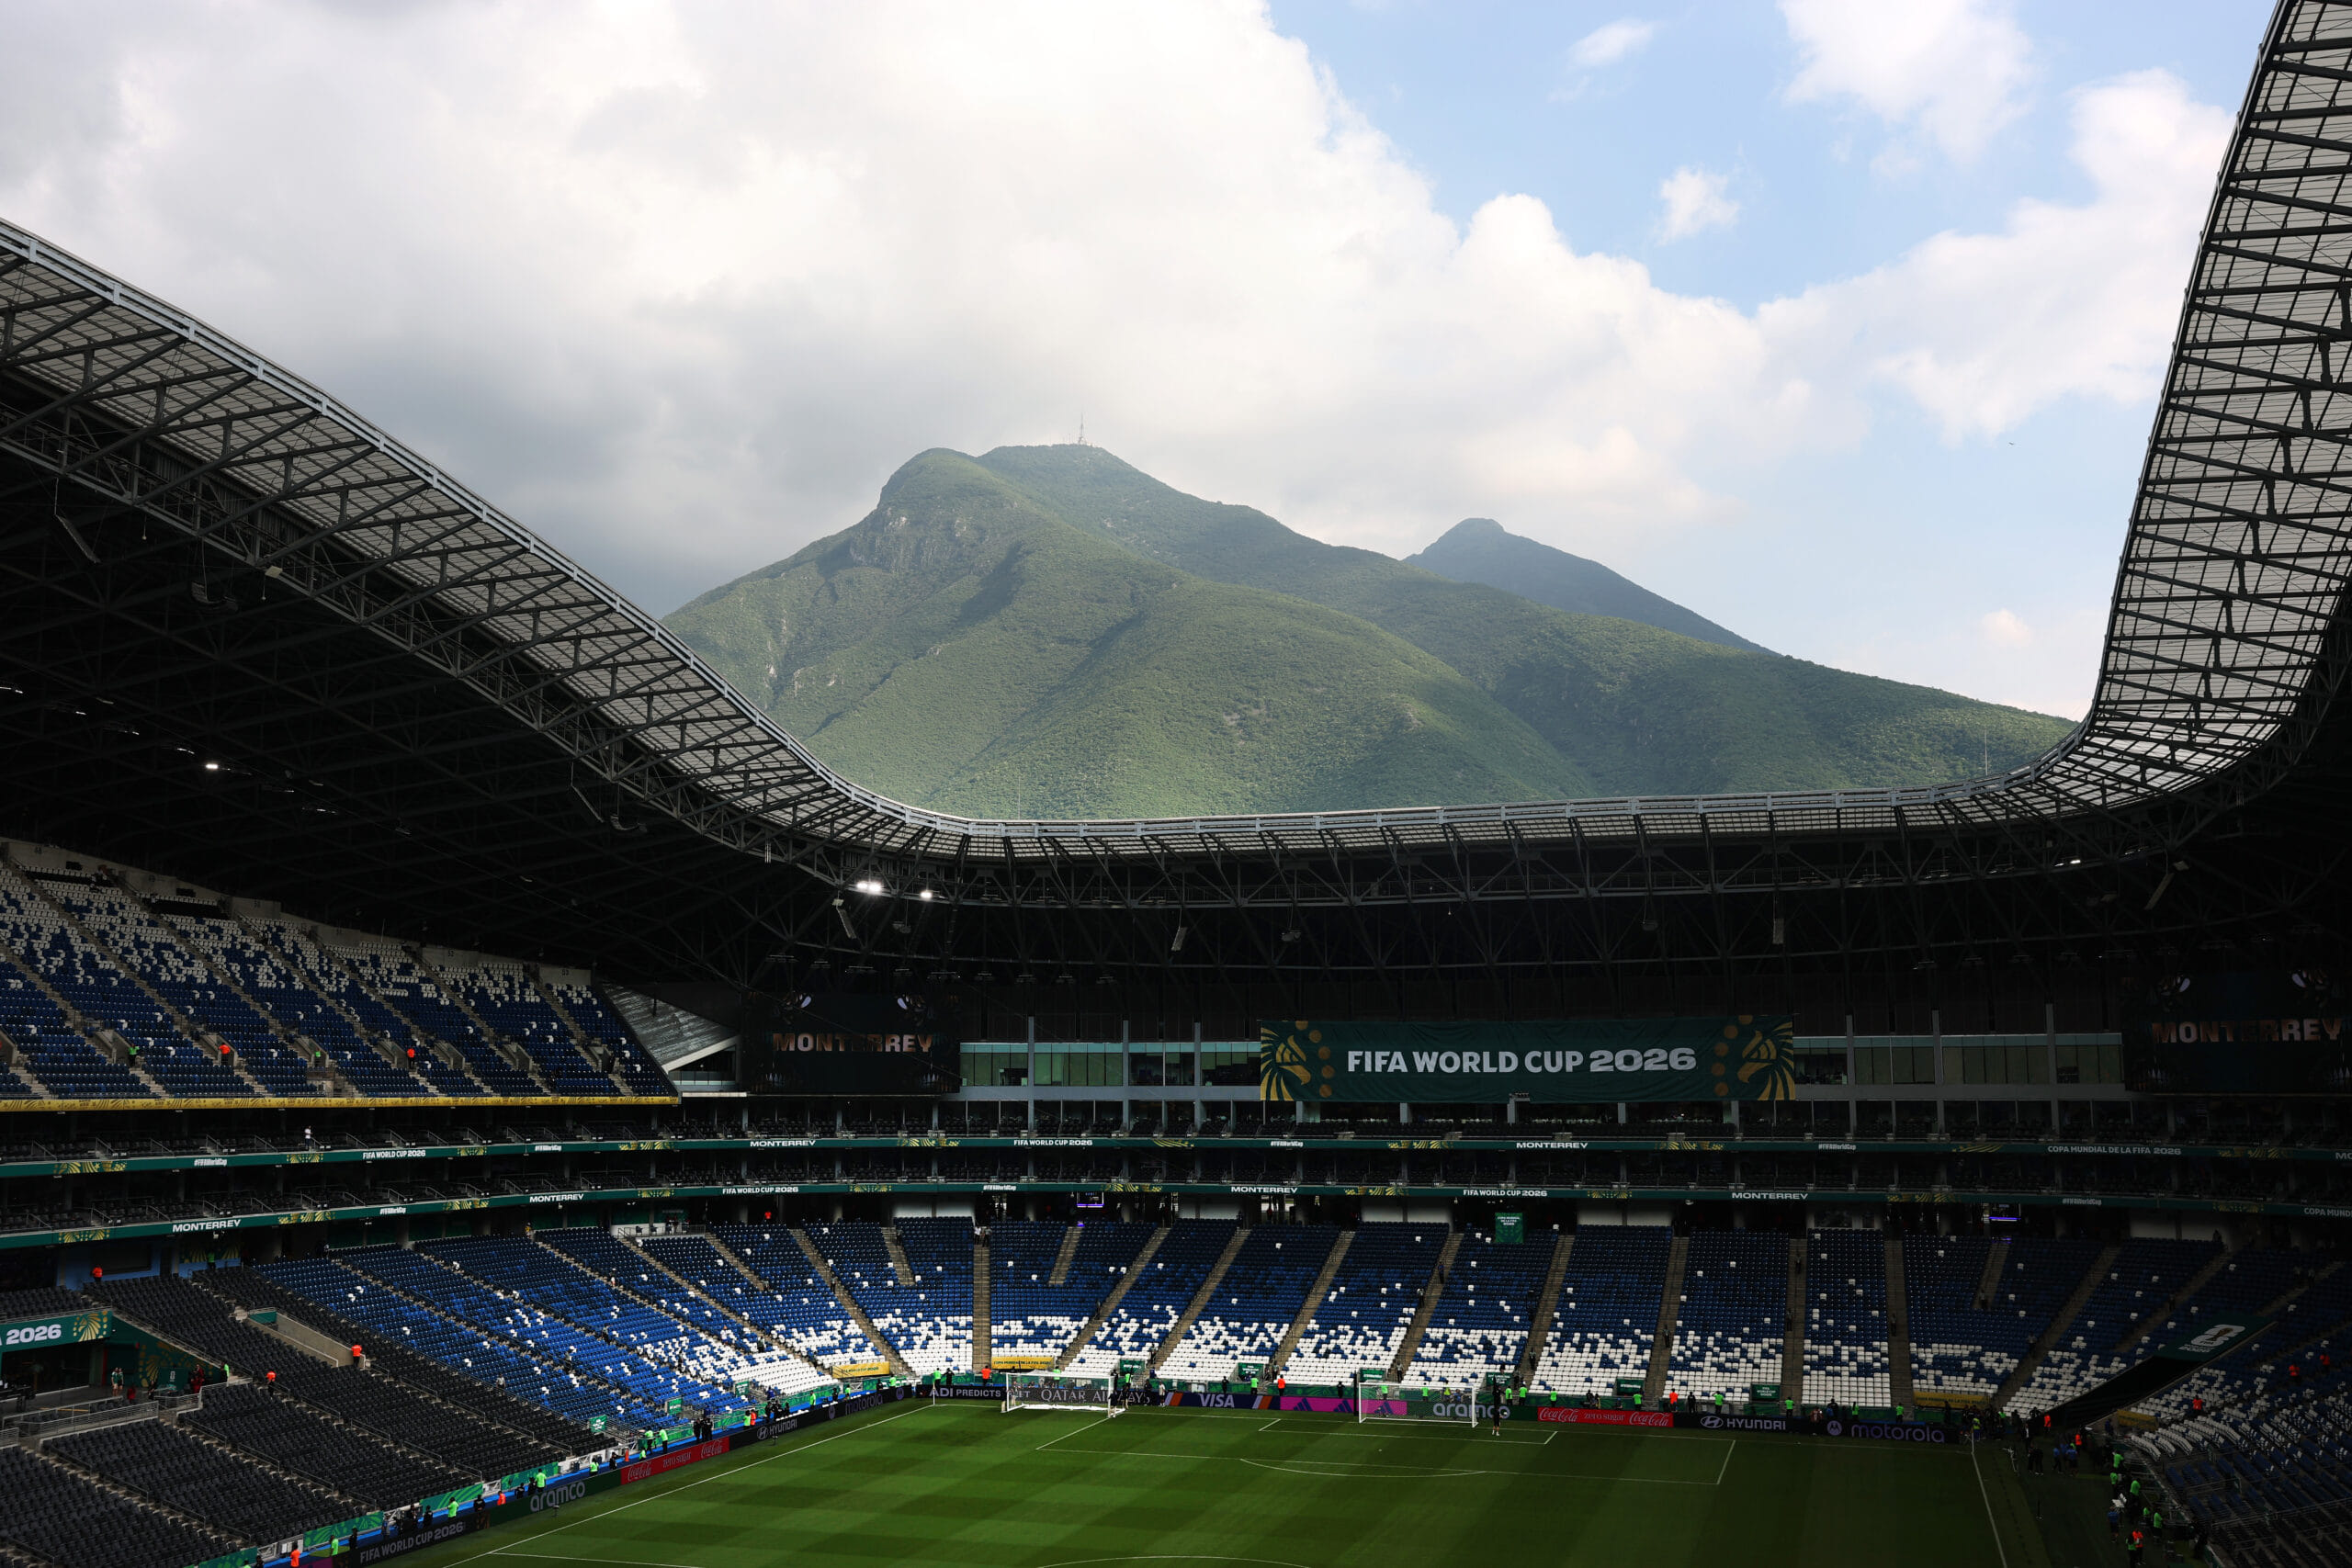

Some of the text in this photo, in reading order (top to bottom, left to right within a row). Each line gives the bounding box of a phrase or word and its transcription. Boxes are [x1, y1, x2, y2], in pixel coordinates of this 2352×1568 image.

[2151, 1018, 2343, 1043] MONTERREY
[773, 1033, 934, 1052] MONTERREY
[1347, 1047, 1697, 1074] FIFA WORLD CUP 2026
[407, 1149, 426, 1157] 2026
[2070, 1145, 2109, 1154] MUNDIAL
[2132, 1146, 2152, 1155] FIFA
[2153, 1147, 2182, 1156] 2026
[1230, 1186, 1298, 1194] MONTERREY
[1732, 1191, 1809, 1200] MONTERREY
[528, 1193, 584, 1203] MONTERREY
[2303, 1207, 2326, 1216] COPA
[172, 1219, 243, 1233] MONTERREY
[6, 1324, 62, 1346] 2026
[929, 1387, 954, 1397] ADI
[1040, 1389, 1086, 1402] QATAR
[845, 1393, 884, 1416] motorola
[1198, 1393, 1235, 1408] VISA
[1432, 1403, 1510, 1419] aramco
[1602, 1413, 1625, 1423] sugar
[769, 1418, 797, 1436] HYUNDAI
[1726, 1417, 1786, 1430] HYUNDAI
[1850, 1423, 1945, 1443] motorola
[676, 1451, 691, 1463] sugar
[530, 1482, 585, 1513] aramco
[359, 1521, 464, 1564] FIFA WORLD CUP 2026
